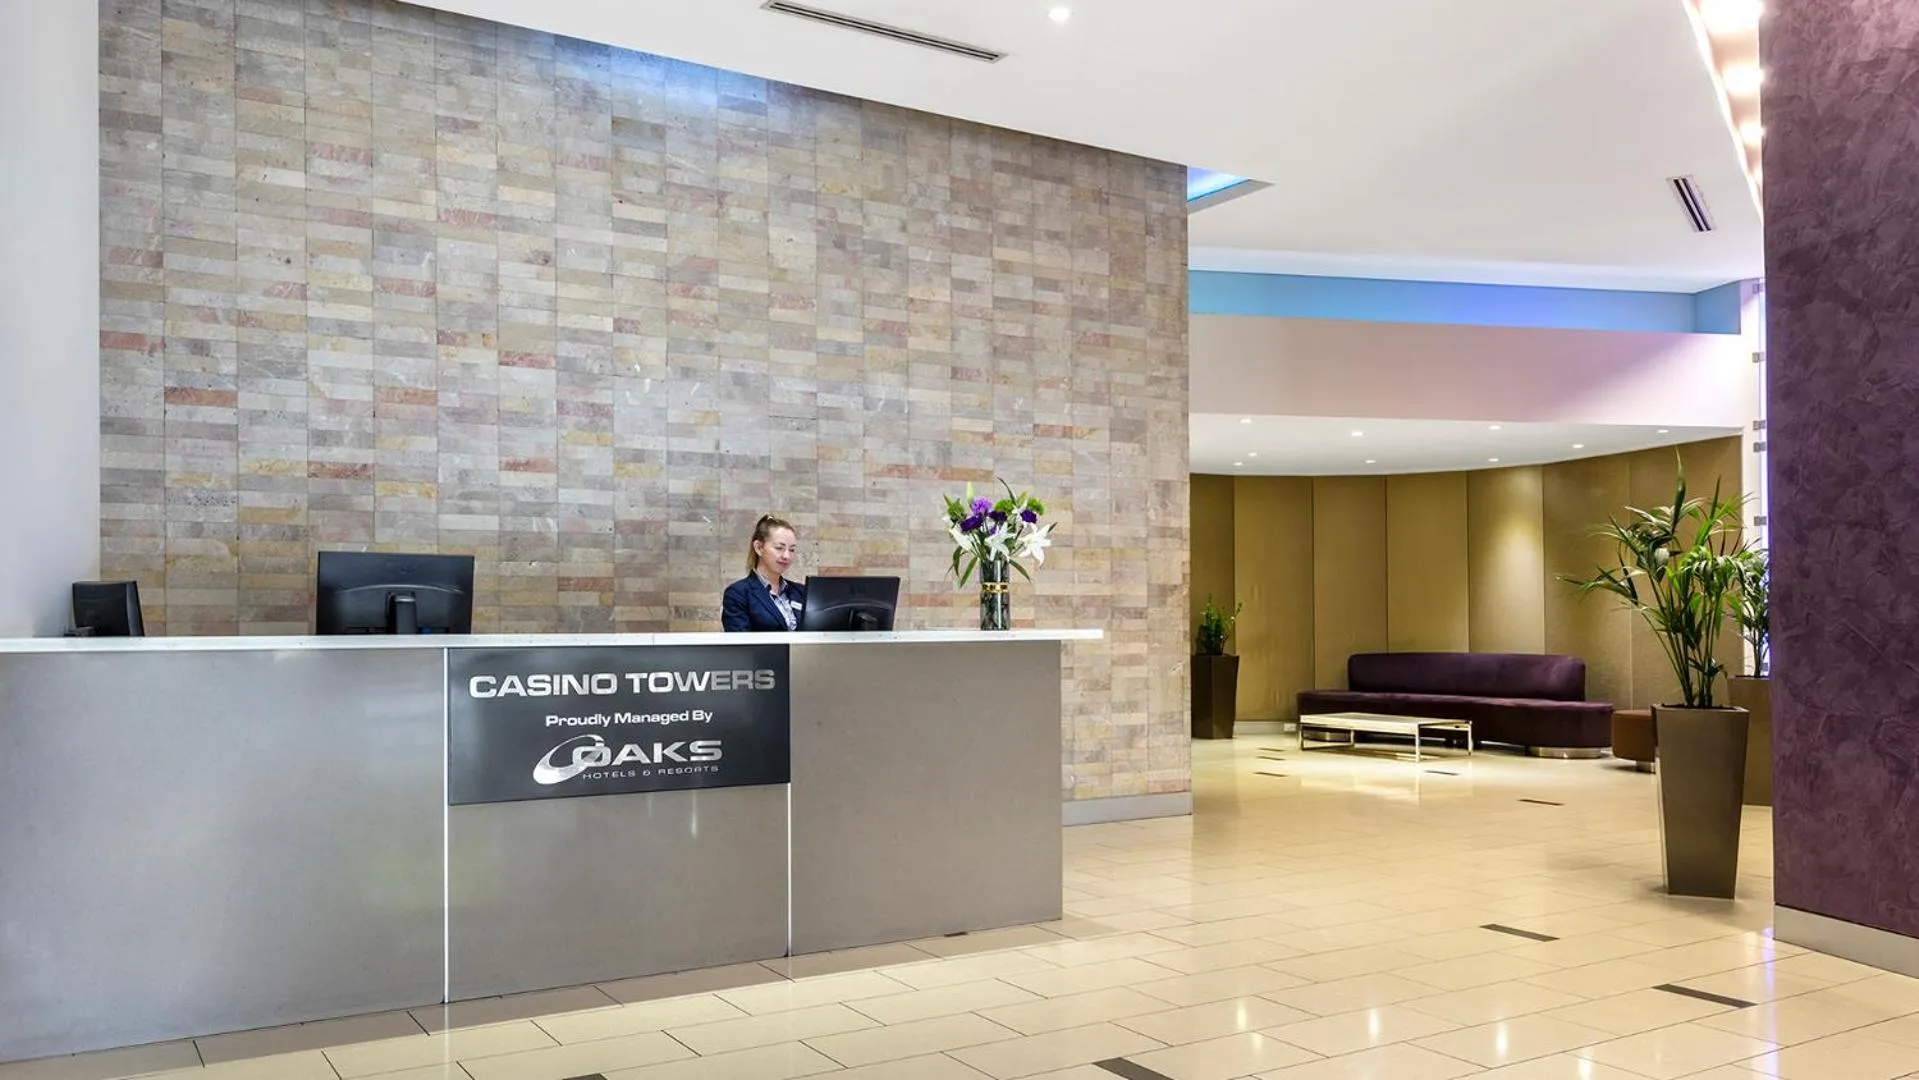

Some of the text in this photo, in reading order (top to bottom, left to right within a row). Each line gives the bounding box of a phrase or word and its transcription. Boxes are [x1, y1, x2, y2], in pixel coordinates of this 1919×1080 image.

[469, 669, 775, 698] CASINO TOWERS
[545, 709, 713, 727] Proudly Managed By
[572, 739, 723, 766] OAKS
[582, 770, 636, 780] HOTELS
[658, 765, 719, 775] RESORTS
